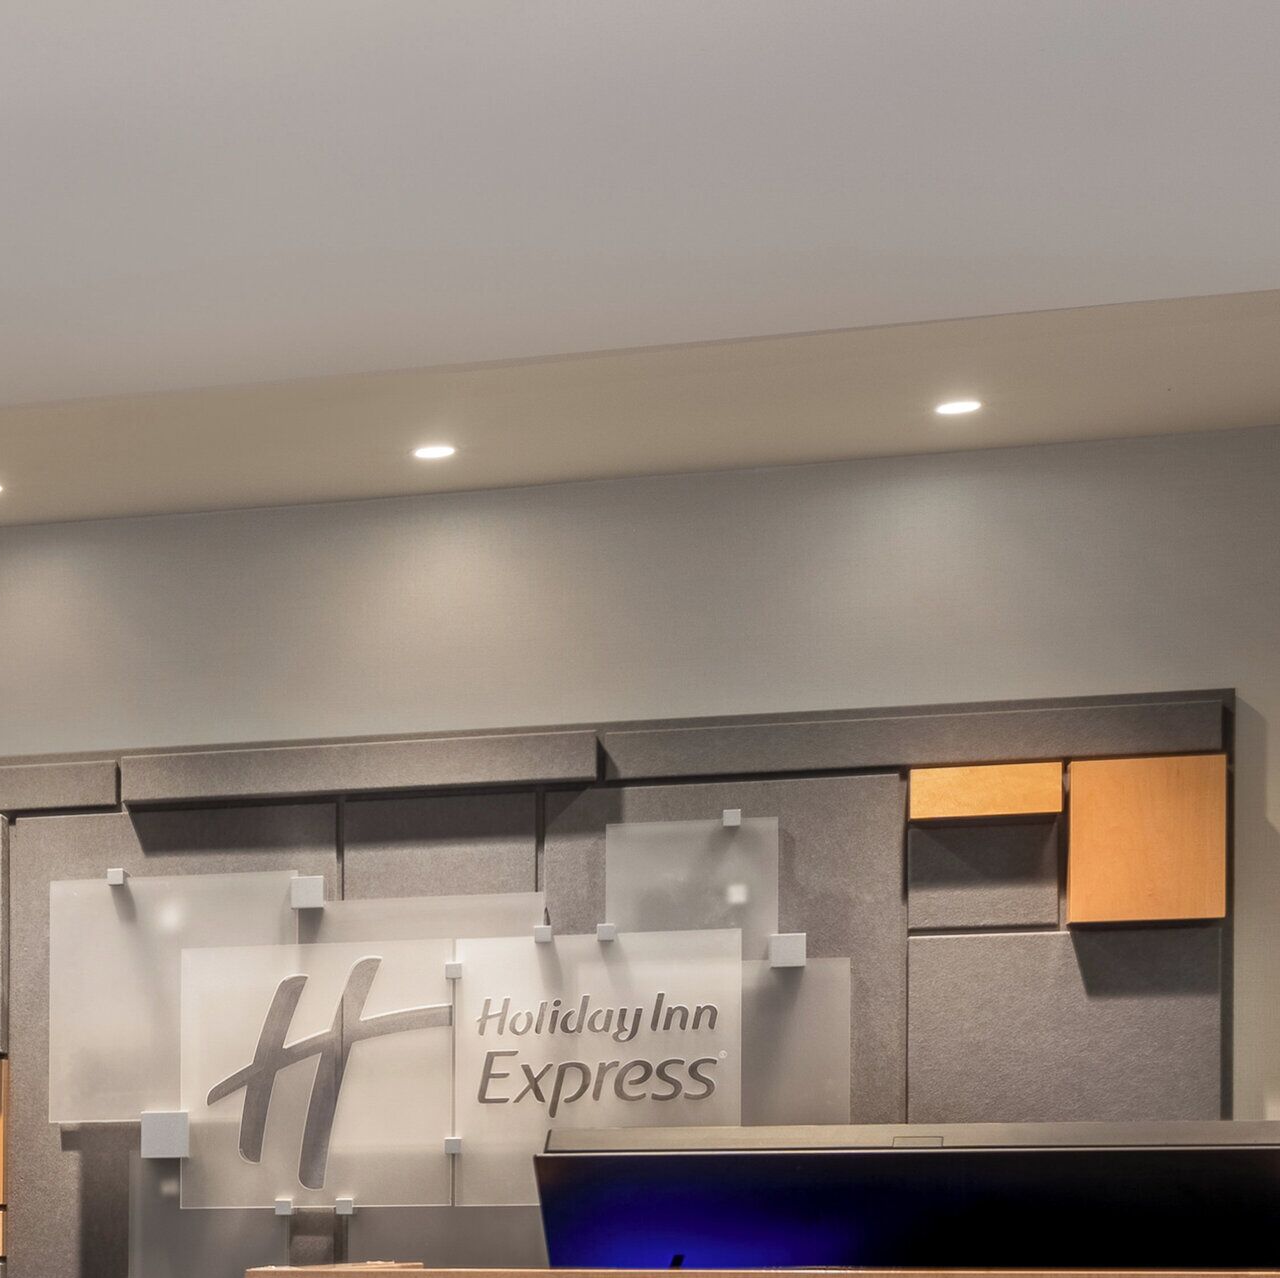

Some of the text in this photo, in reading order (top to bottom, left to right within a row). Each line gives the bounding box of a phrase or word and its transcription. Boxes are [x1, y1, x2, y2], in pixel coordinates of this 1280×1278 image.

[476, 992, 719, 1043] Holiday Inn
[477, 1050, 718, 1119] Express
